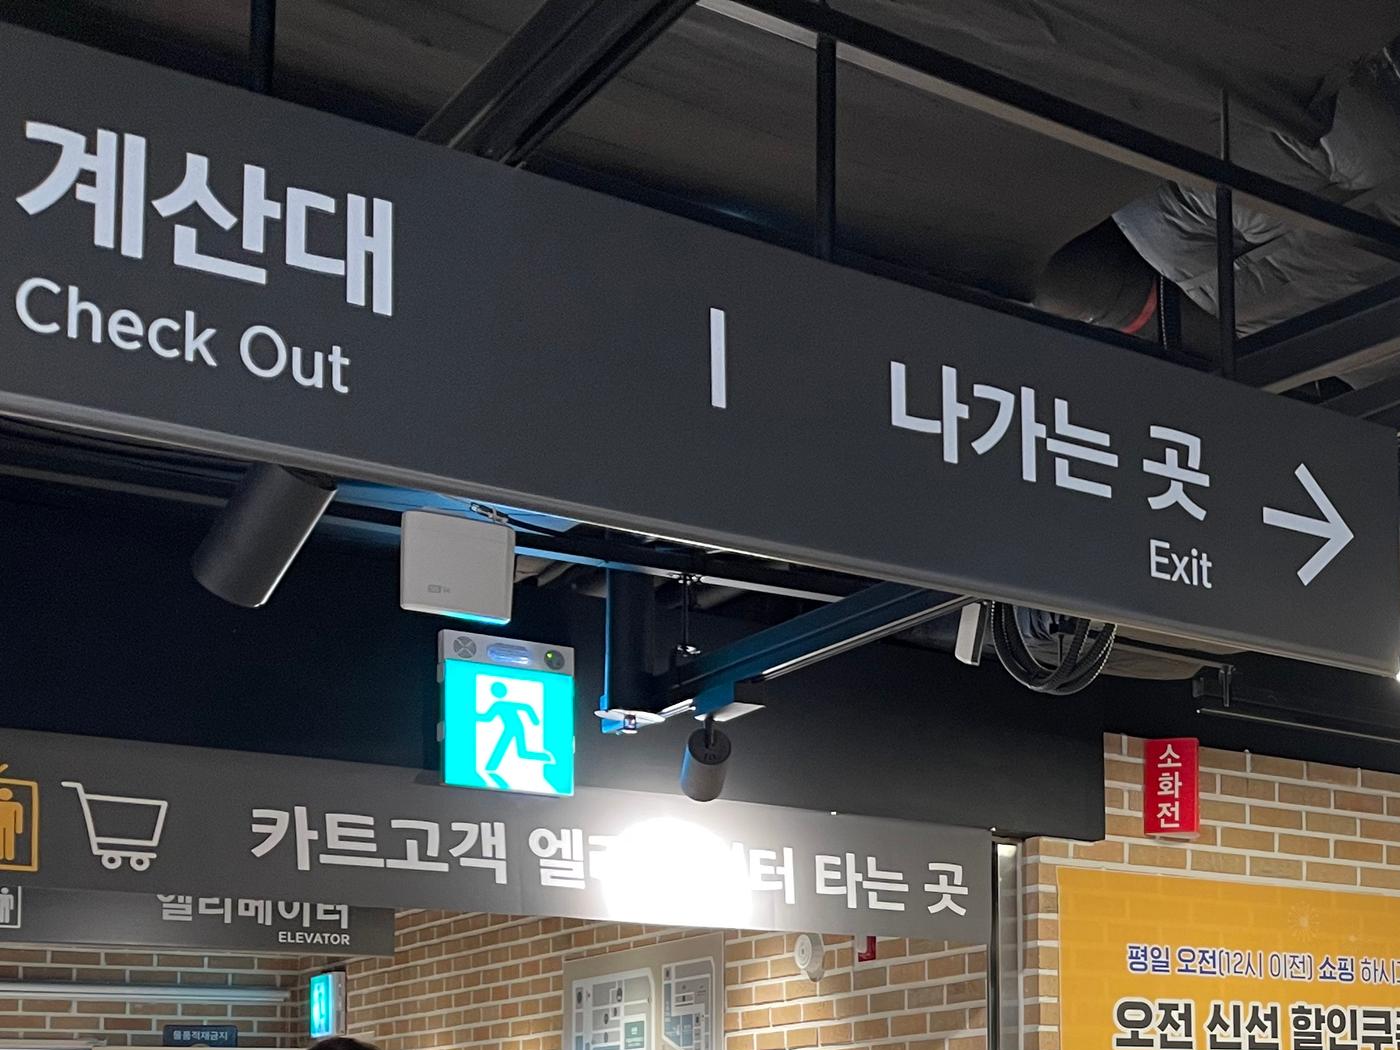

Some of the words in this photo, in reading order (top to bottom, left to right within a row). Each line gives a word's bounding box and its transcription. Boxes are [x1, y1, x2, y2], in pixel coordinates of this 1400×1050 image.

[16, 121, 392, 316] 계산대
[16, 277, 217, 366] Check
[240, 325, 350, 393] Out
[891, 361, 1118, 498] 나가는
[1143, 425, 1210, 521] 곳
[1150, 538, 1212, 589] Exit
[1156, 743, 1182, 828] 소화전
[251, 806, 507, 884] 카트고객
[815, 852, 909, 911] 타는
[924, 861, 969, 917] 곳
[278, 931, 350, 945] ELEVATOR
[1127, 945, 1170, 973] 평일
[1177, 948, 1262, 979] 오전(12시
[1270, 952, 1313, 980] 이전)
[1319, 957, 1355, 982] 쇼핑
[1115, 1001, 1194, 1050] 오전
